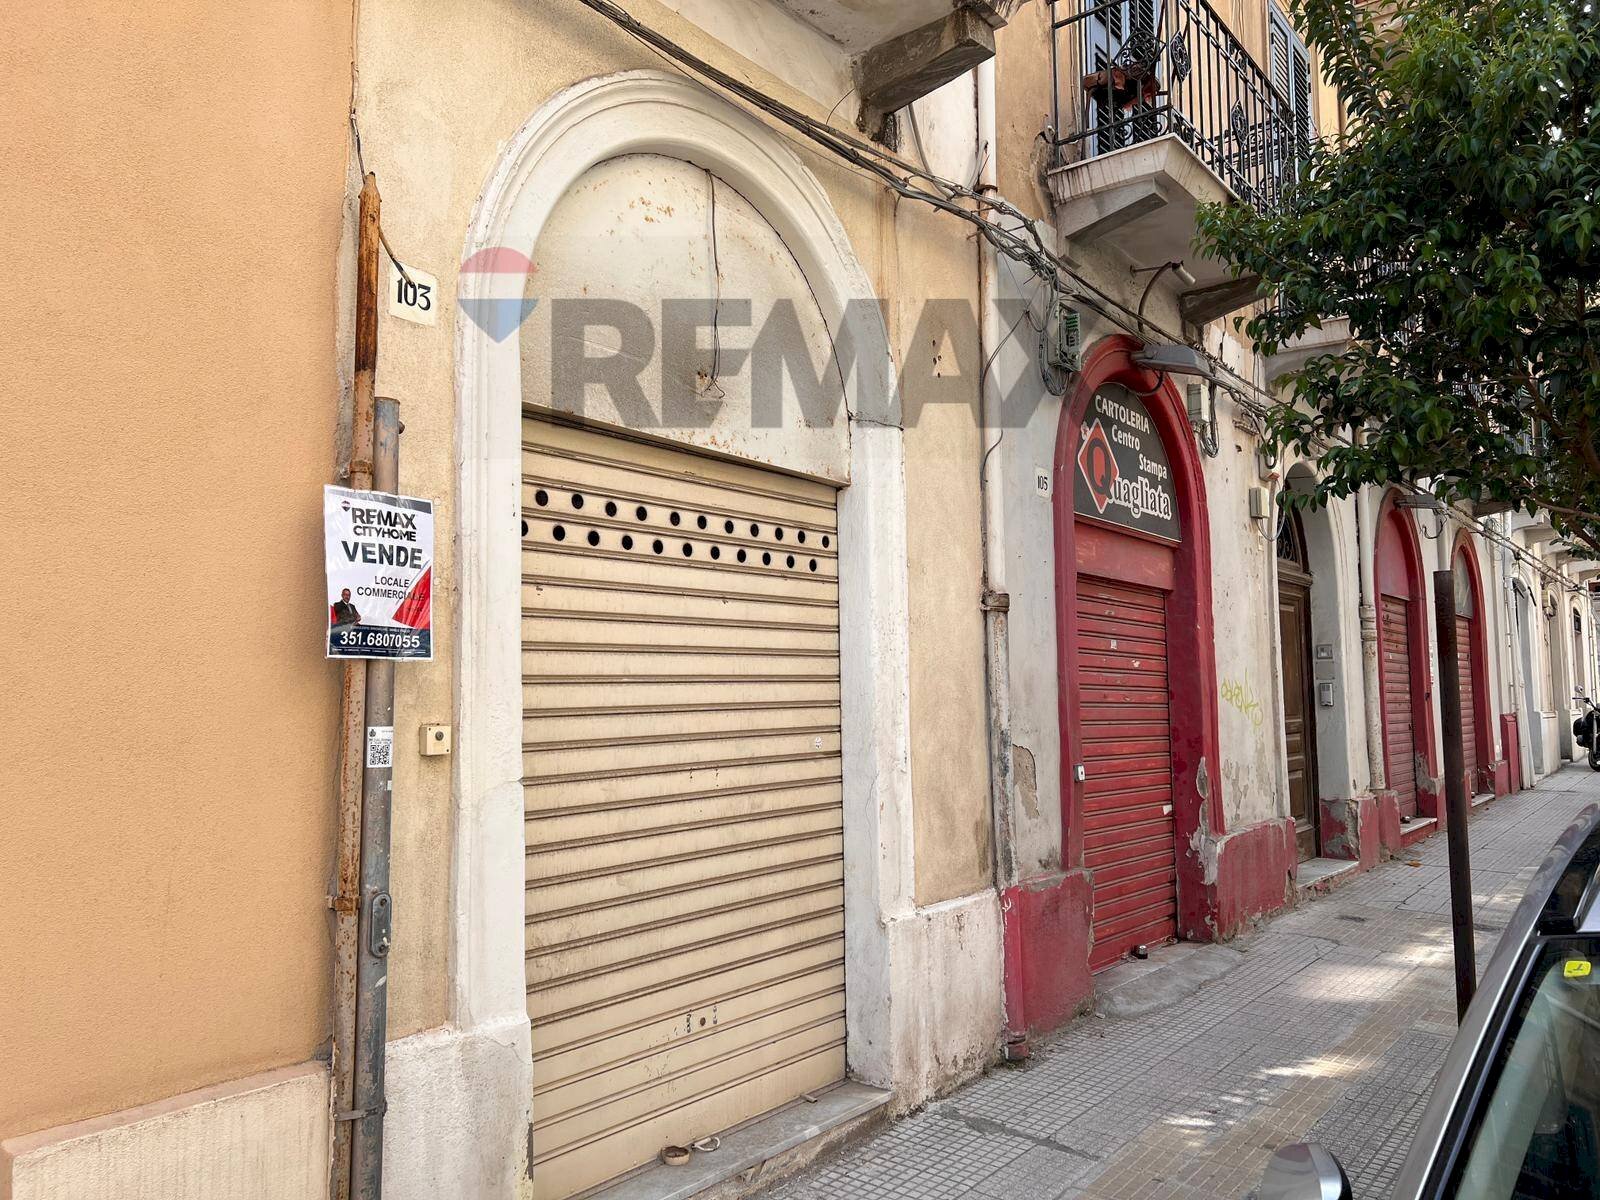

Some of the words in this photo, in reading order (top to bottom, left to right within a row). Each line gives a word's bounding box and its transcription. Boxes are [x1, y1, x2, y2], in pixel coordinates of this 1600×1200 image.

[397, 277, 431, 311] 103
[1095, 395, 1150, 434] CARTOLERIA
[1111, 424, 1140, 451] Centro
[1087, 438, 1172, 520] Quagliata
[1139, 453, 1168, 480] Stampa
[1037, 475, 1048, 491] 105
[352, 507, 417, 530] REMAX
[341, 540, 423, 569] VENDE
[375, 575, 410, 588] LOCALE
[340, 631, 420, 648] 351.6807055
